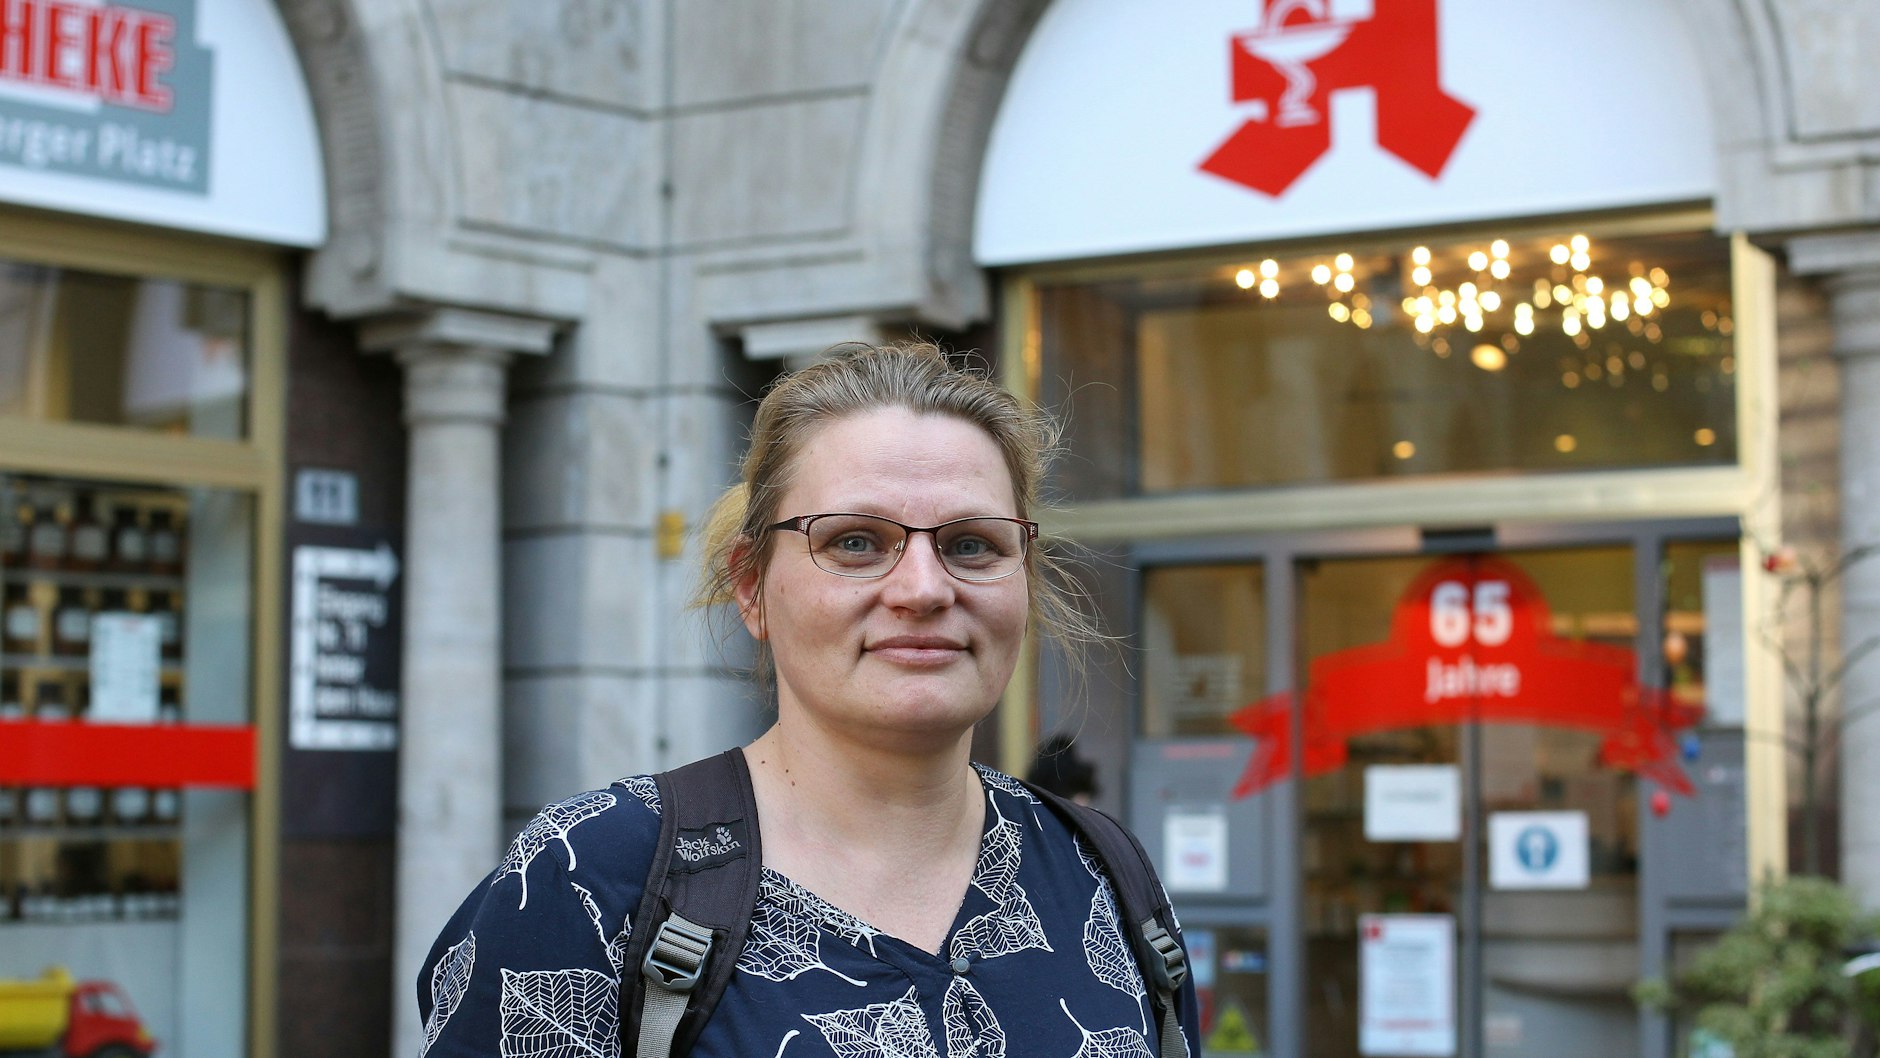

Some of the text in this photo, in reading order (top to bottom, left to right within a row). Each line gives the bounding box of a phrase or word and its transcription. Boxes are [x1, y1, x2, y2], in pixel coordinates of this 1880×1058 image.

[0, 0, 176, 115] HEKE
[0, 115, 197, 183] rger Platz
[1429, 580, 1514, 648] 65
[1424, 654, 1521, 704] Jahre
[675, 837, 710, 851] Jack
[676, 840, 741, 862] Wolfskin
